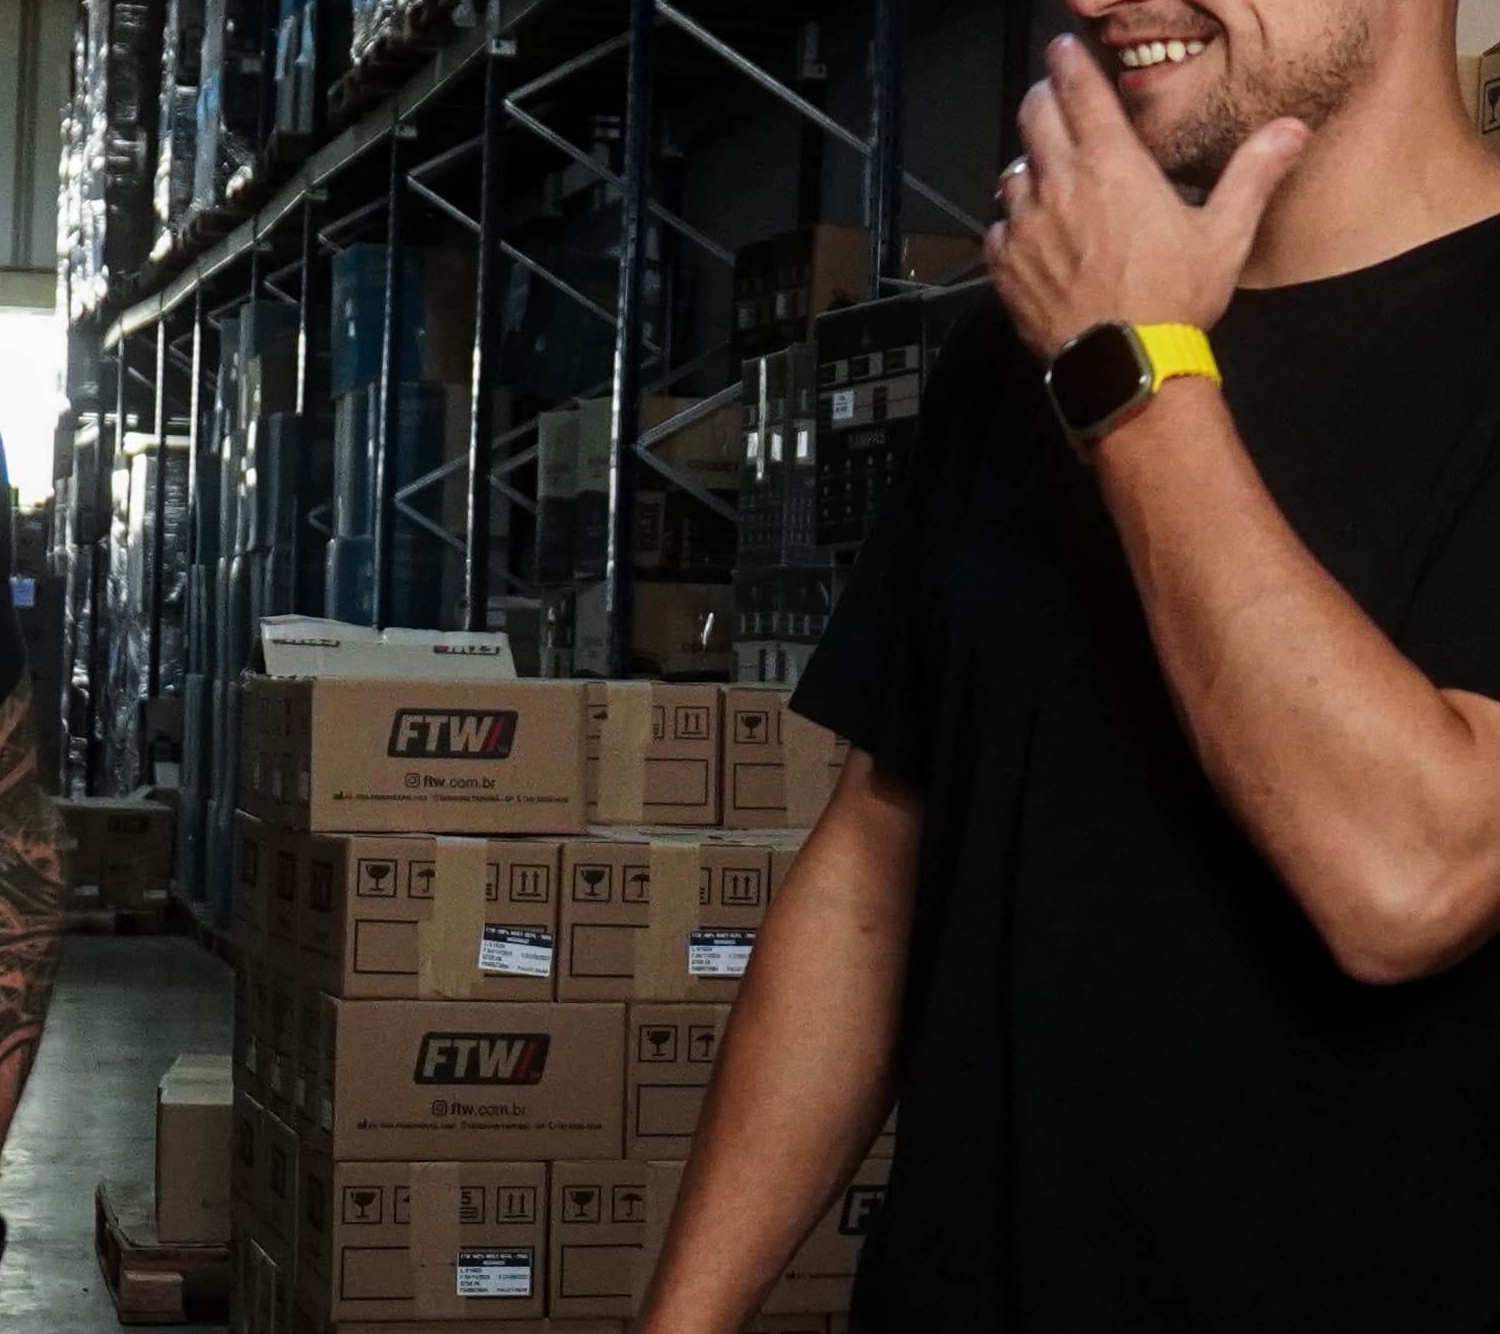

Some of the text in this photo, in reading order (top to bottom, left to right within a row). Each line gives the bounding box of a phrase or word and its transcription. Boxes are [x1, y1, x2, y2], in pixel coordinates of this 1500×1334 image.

[396, 715, 494, 752] FTW
[423, 774, 496, 788] ftw.com.br
[422, 1039, 525, 1078] FTW
[451, 1101, 526, 1116] ftw.com.br
